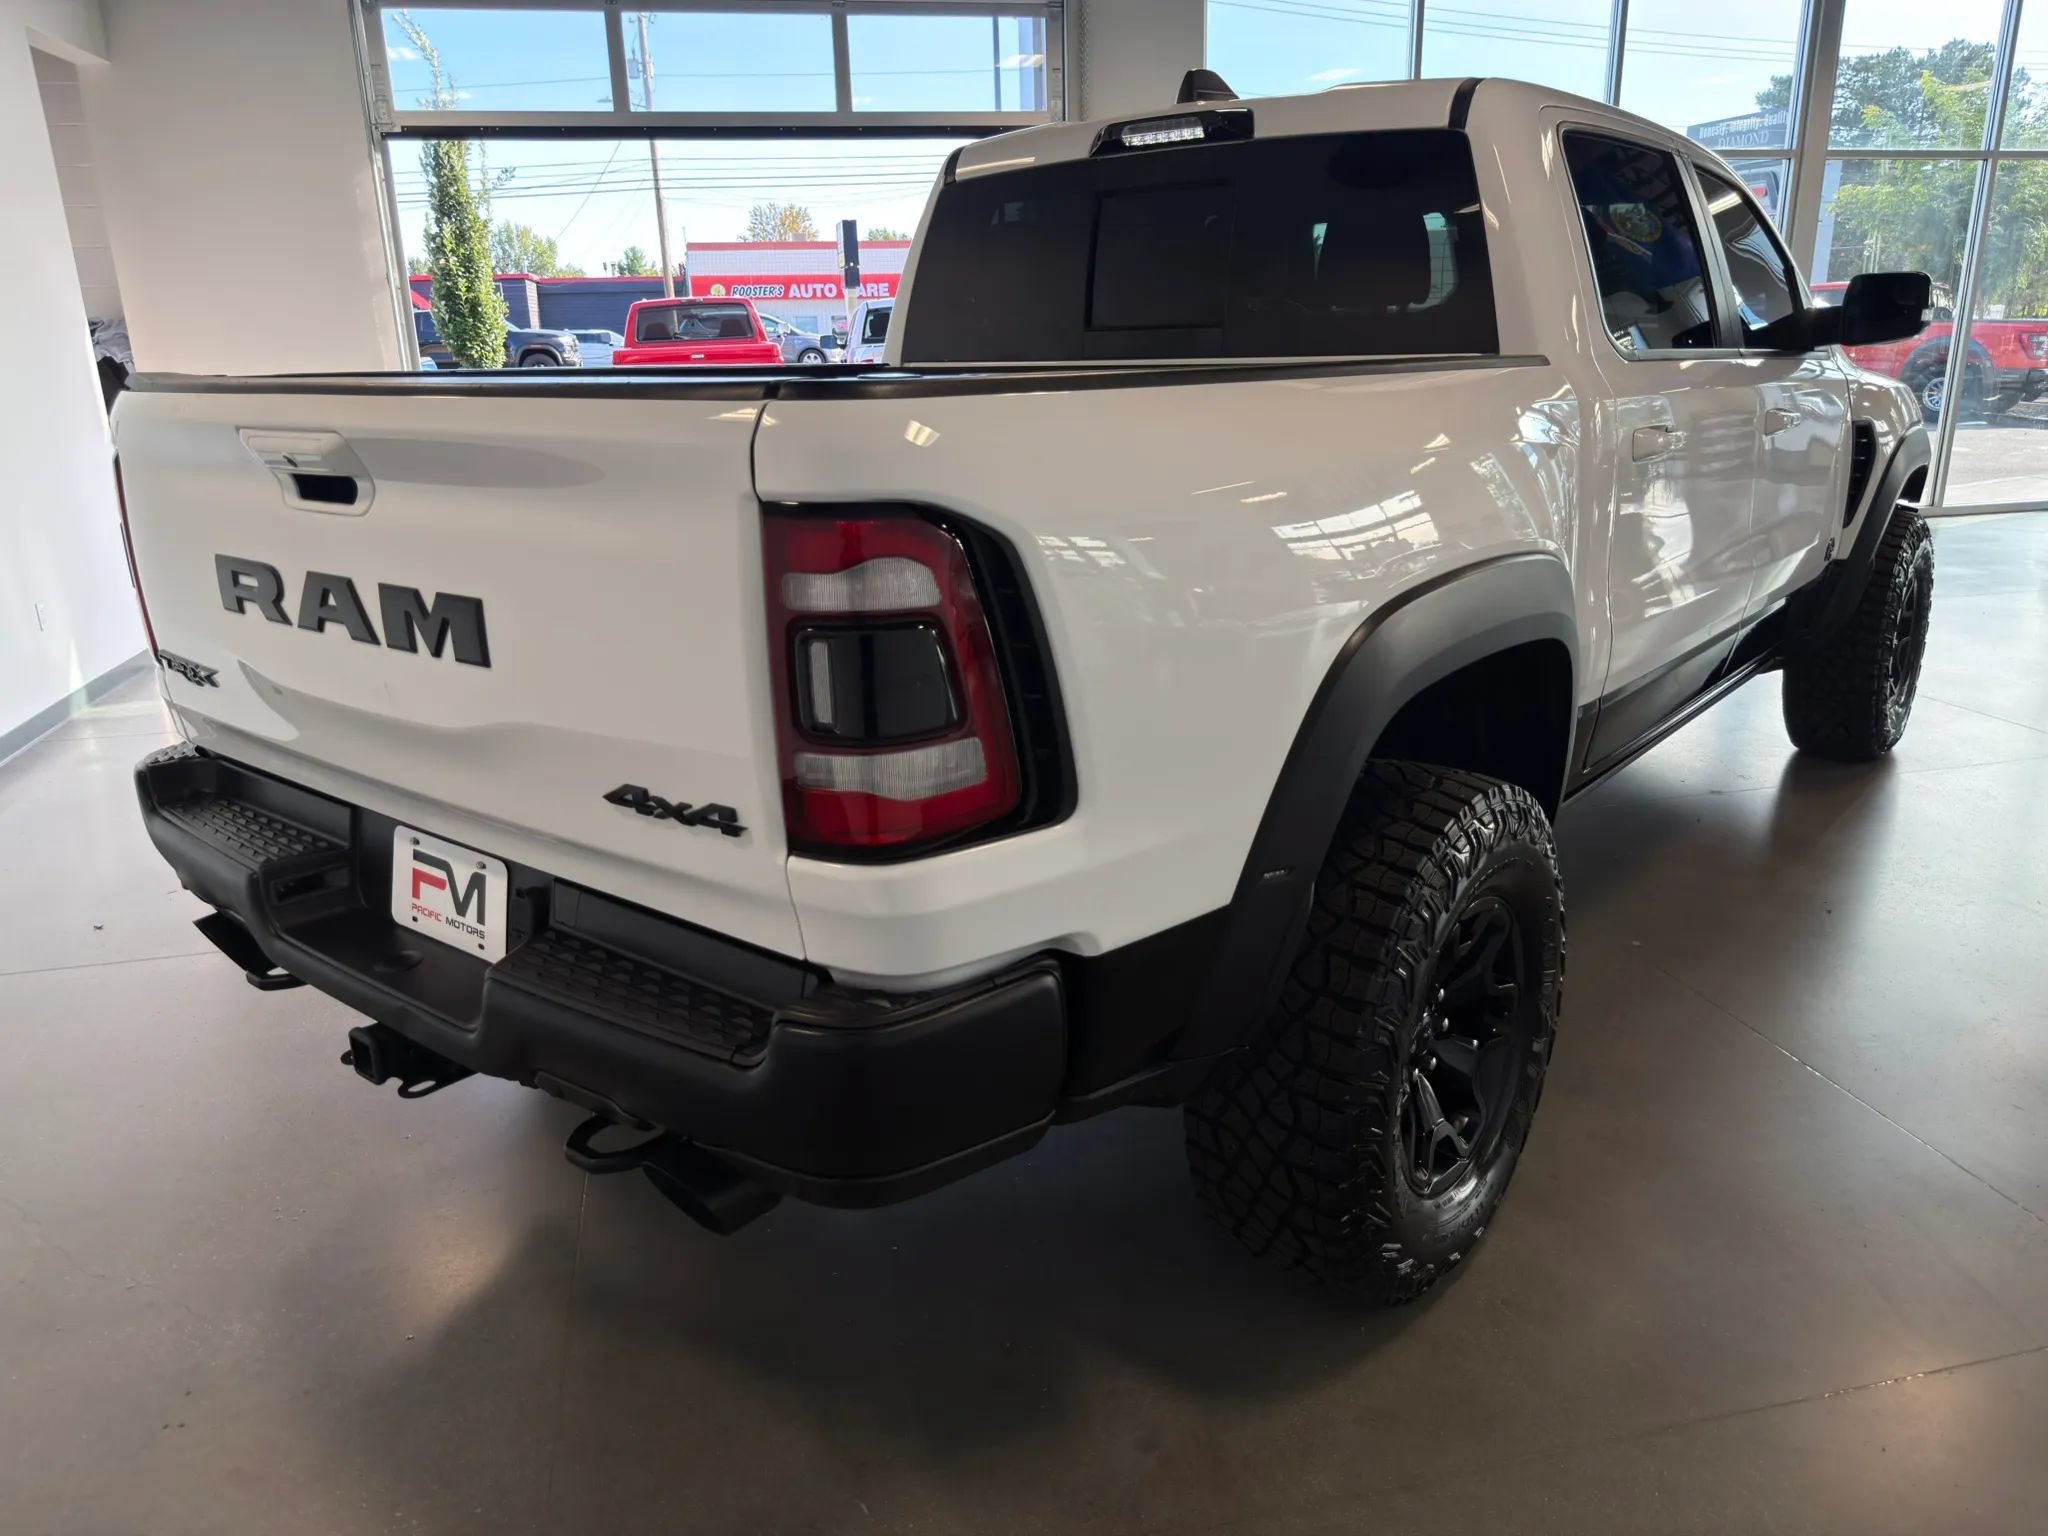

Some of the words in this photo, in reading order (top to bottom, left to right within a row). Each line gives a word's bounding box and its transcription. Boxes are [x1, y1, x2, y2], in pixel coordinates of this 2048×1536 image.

[1718, 130, 1769, 148] DIAMOND
[731, 284, 785, 299] ROOSTER'S
[788, 283, 837, 298] AUTO
[844, 283, 890, 298] ARE
[215, 554, 491, 668] RAM
[411, 902, 442, 923] PACIFIC
[445, 916, 486, 940] MOTORS
